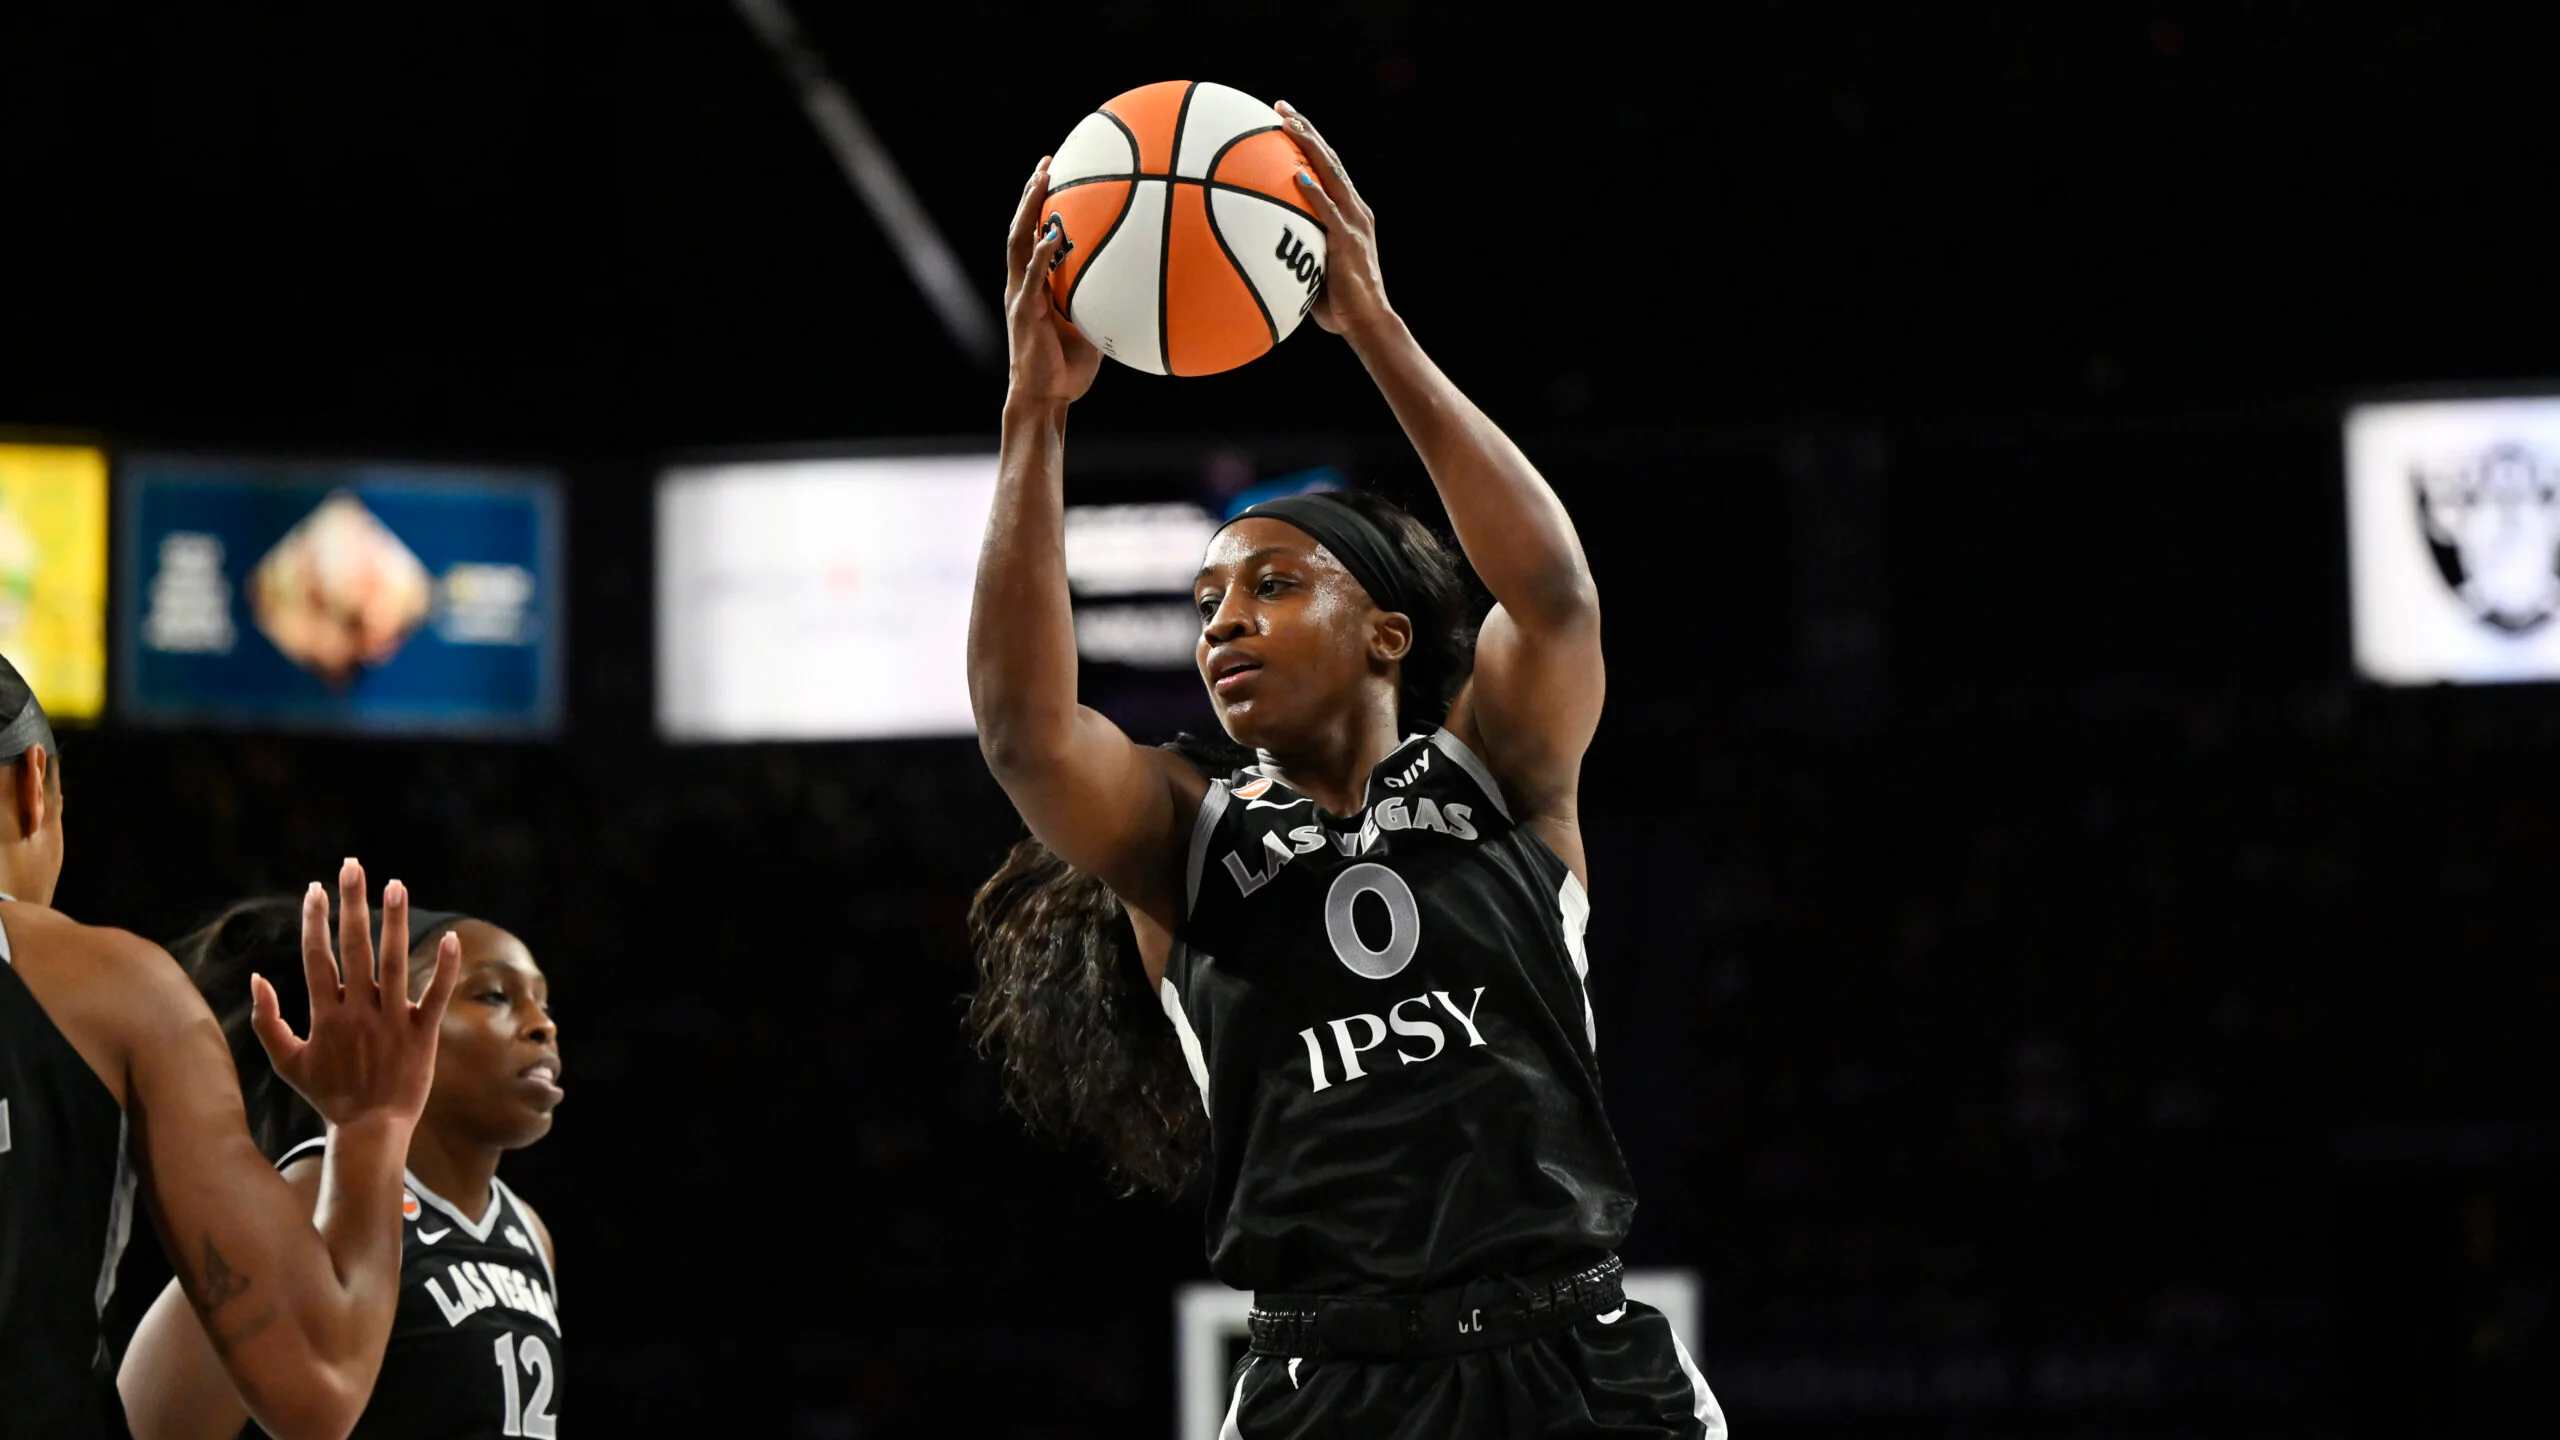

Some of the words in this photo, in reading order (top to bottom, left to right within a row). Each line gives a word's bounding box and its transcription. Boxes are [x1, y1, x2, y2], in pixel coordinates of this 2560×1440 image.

[1222, 825, 1326, 898] LAS
[1328, 796, 1479, 857] VEGAS
[1325, 863, 1420, 980] 0
[1299, 986, 1487, 1093] IPSY
[424, 1261, 496, 1328] LAS
[494, 1331, 557, 1440] 12
